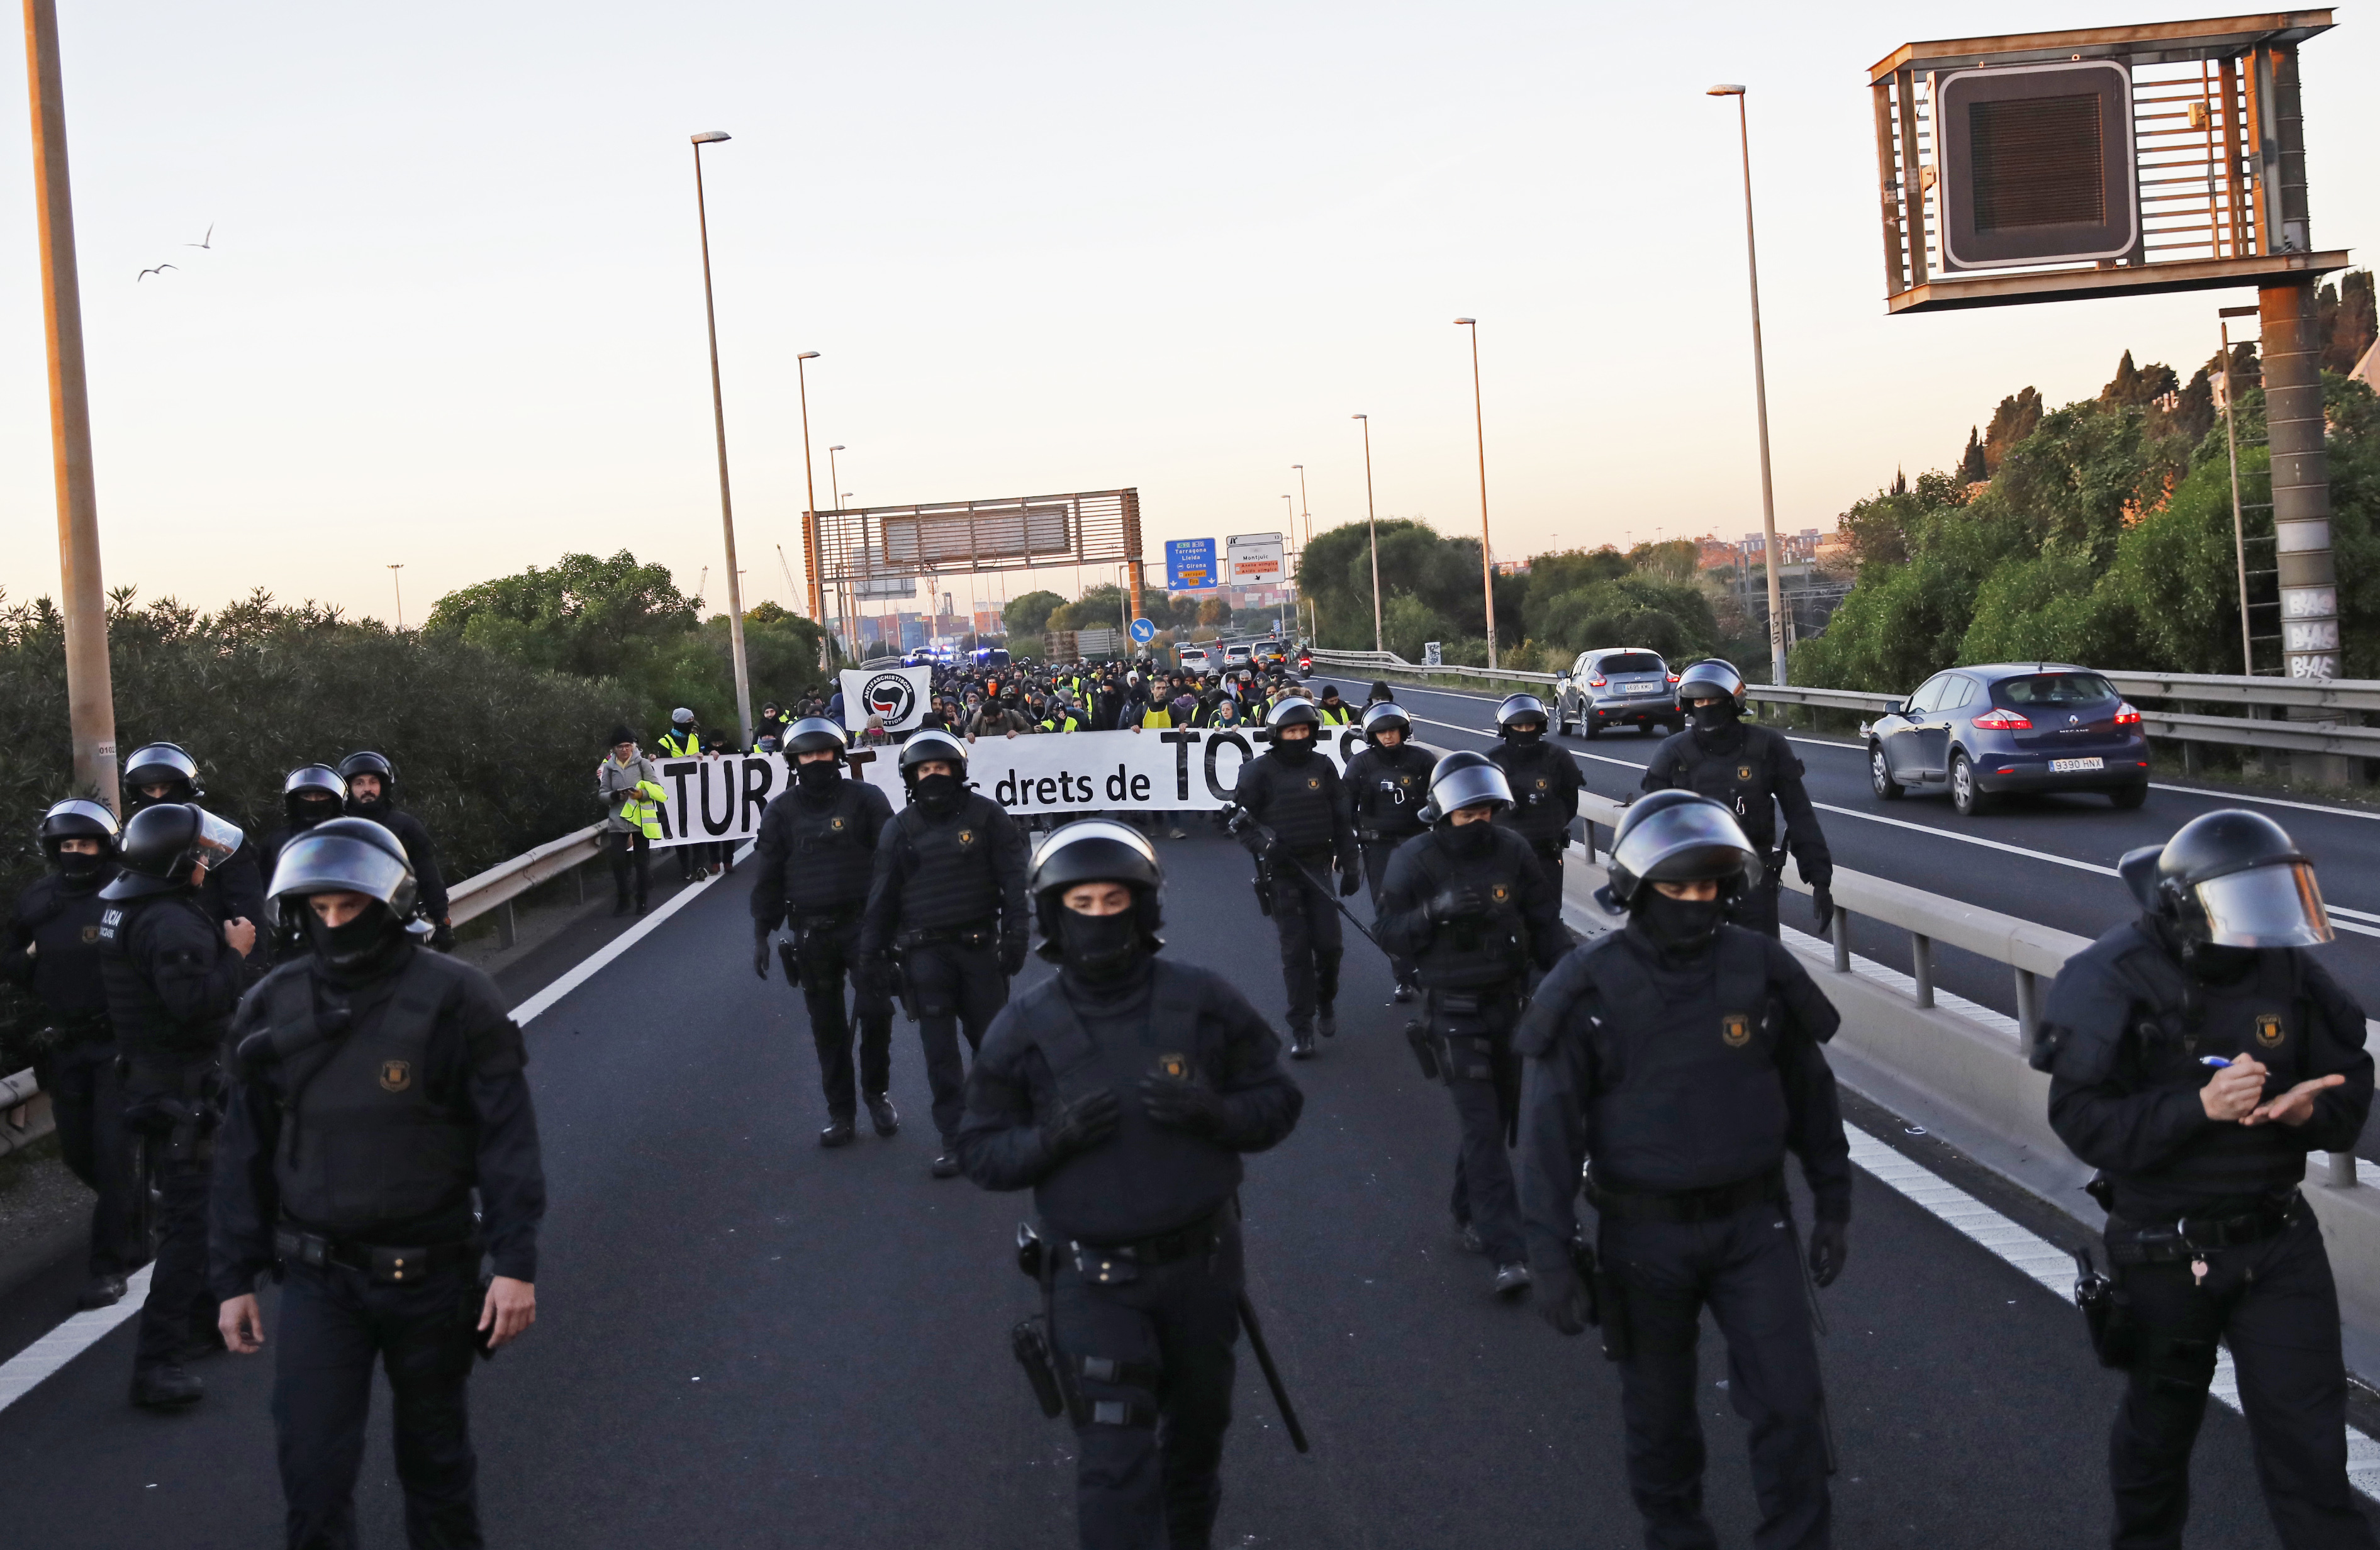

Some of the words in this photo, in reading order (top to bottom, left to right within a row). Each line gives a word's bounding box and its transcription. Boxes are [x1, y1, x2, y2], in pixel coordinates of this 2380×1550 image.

[864, 675, 912, 700] ANTIFASCHISTISCHE
[2055, 760, 2080, 769] 9390
[2082, 759, 2101, 767] HNX
[995, 768, 1093, 807] drets
[1106, 763, 1151, 801] de
